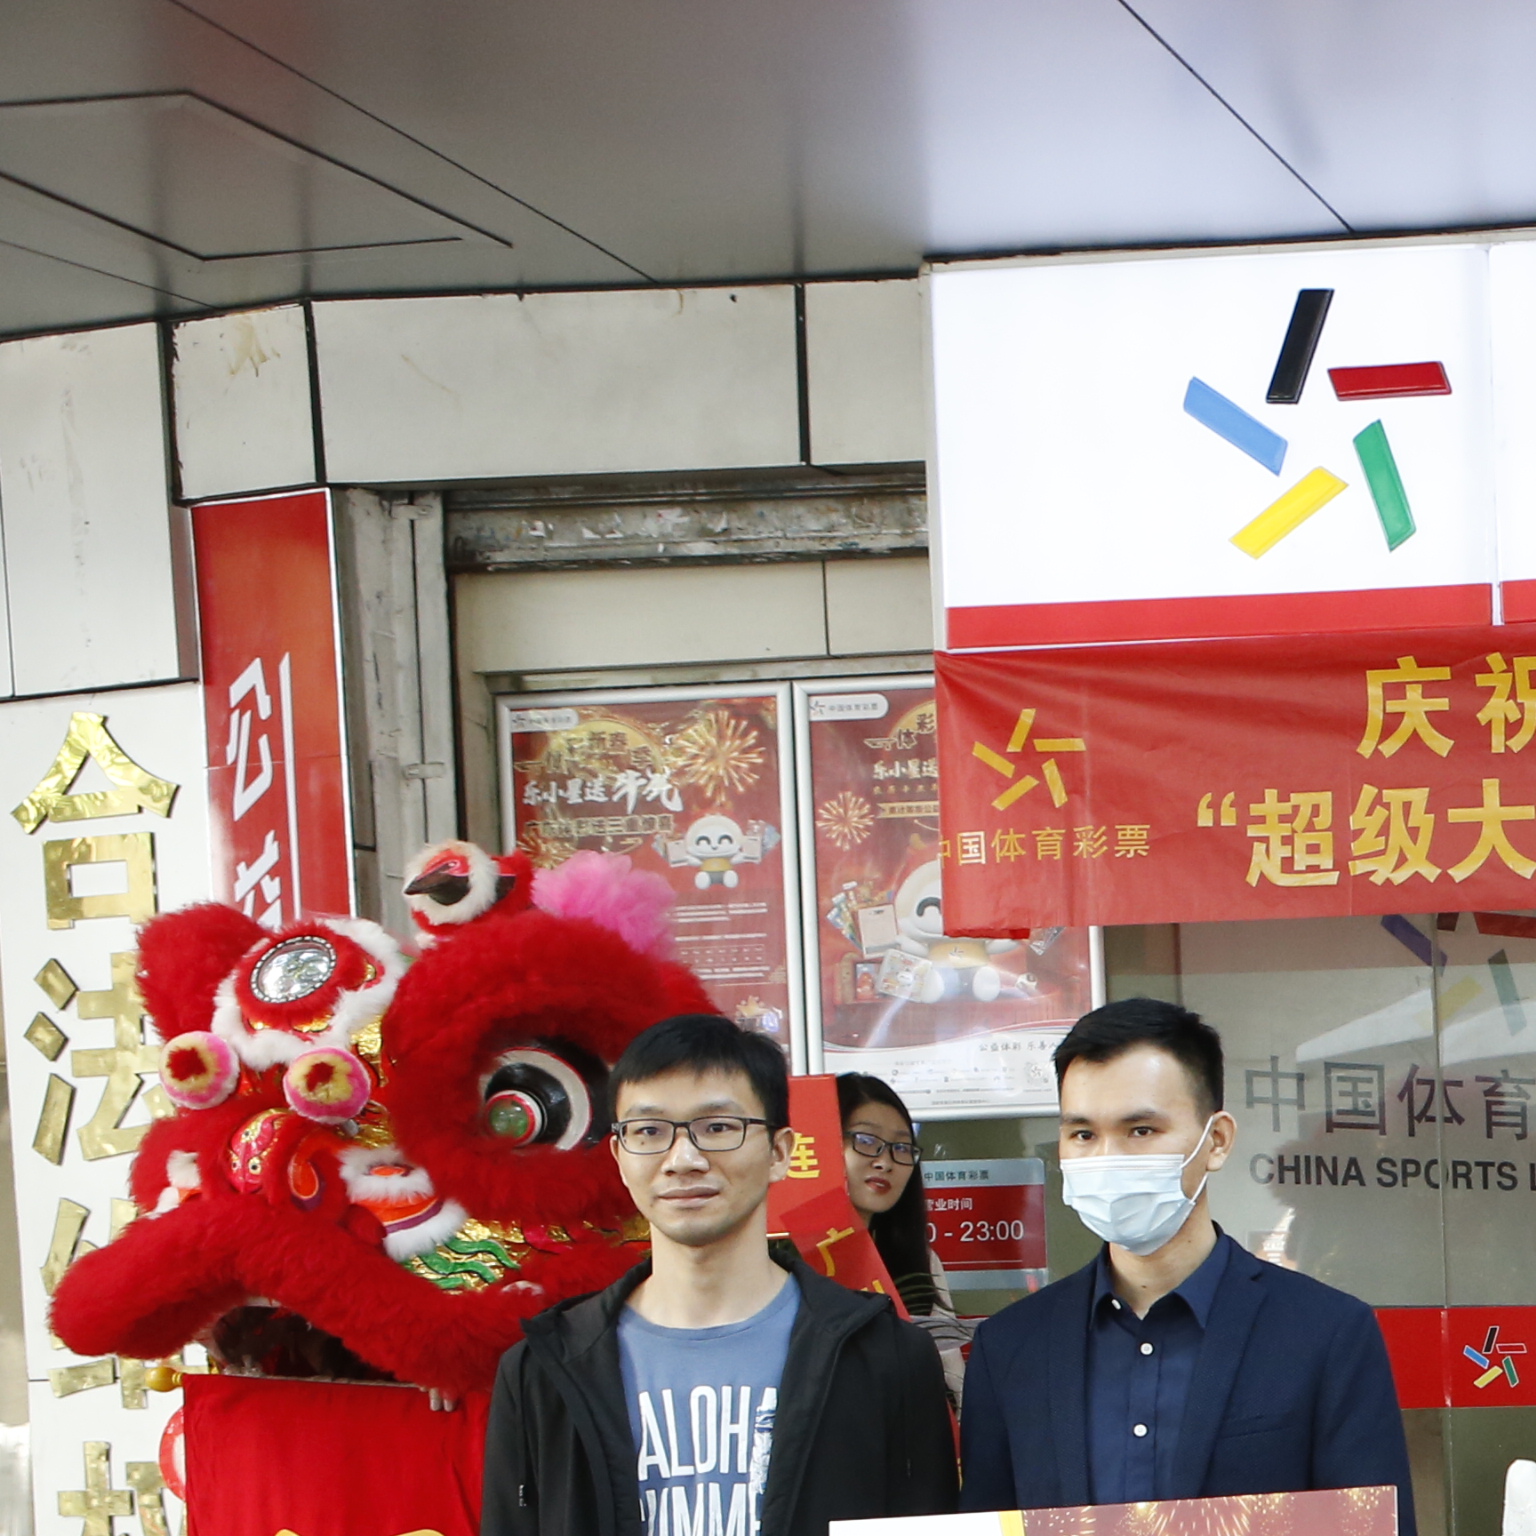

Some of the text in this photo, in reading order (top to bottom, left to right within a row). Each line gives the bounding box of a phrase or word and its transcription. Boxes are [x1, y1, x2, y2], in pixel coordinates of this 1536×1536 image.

[924, 1169, 989, 1182] 中国体育彩票
[1249, 1153, 1366, 1188] CHINA
[1376, 1156, 1518, 1191] SPORTS
[960, 1220, 1024, 1242] 23:00
